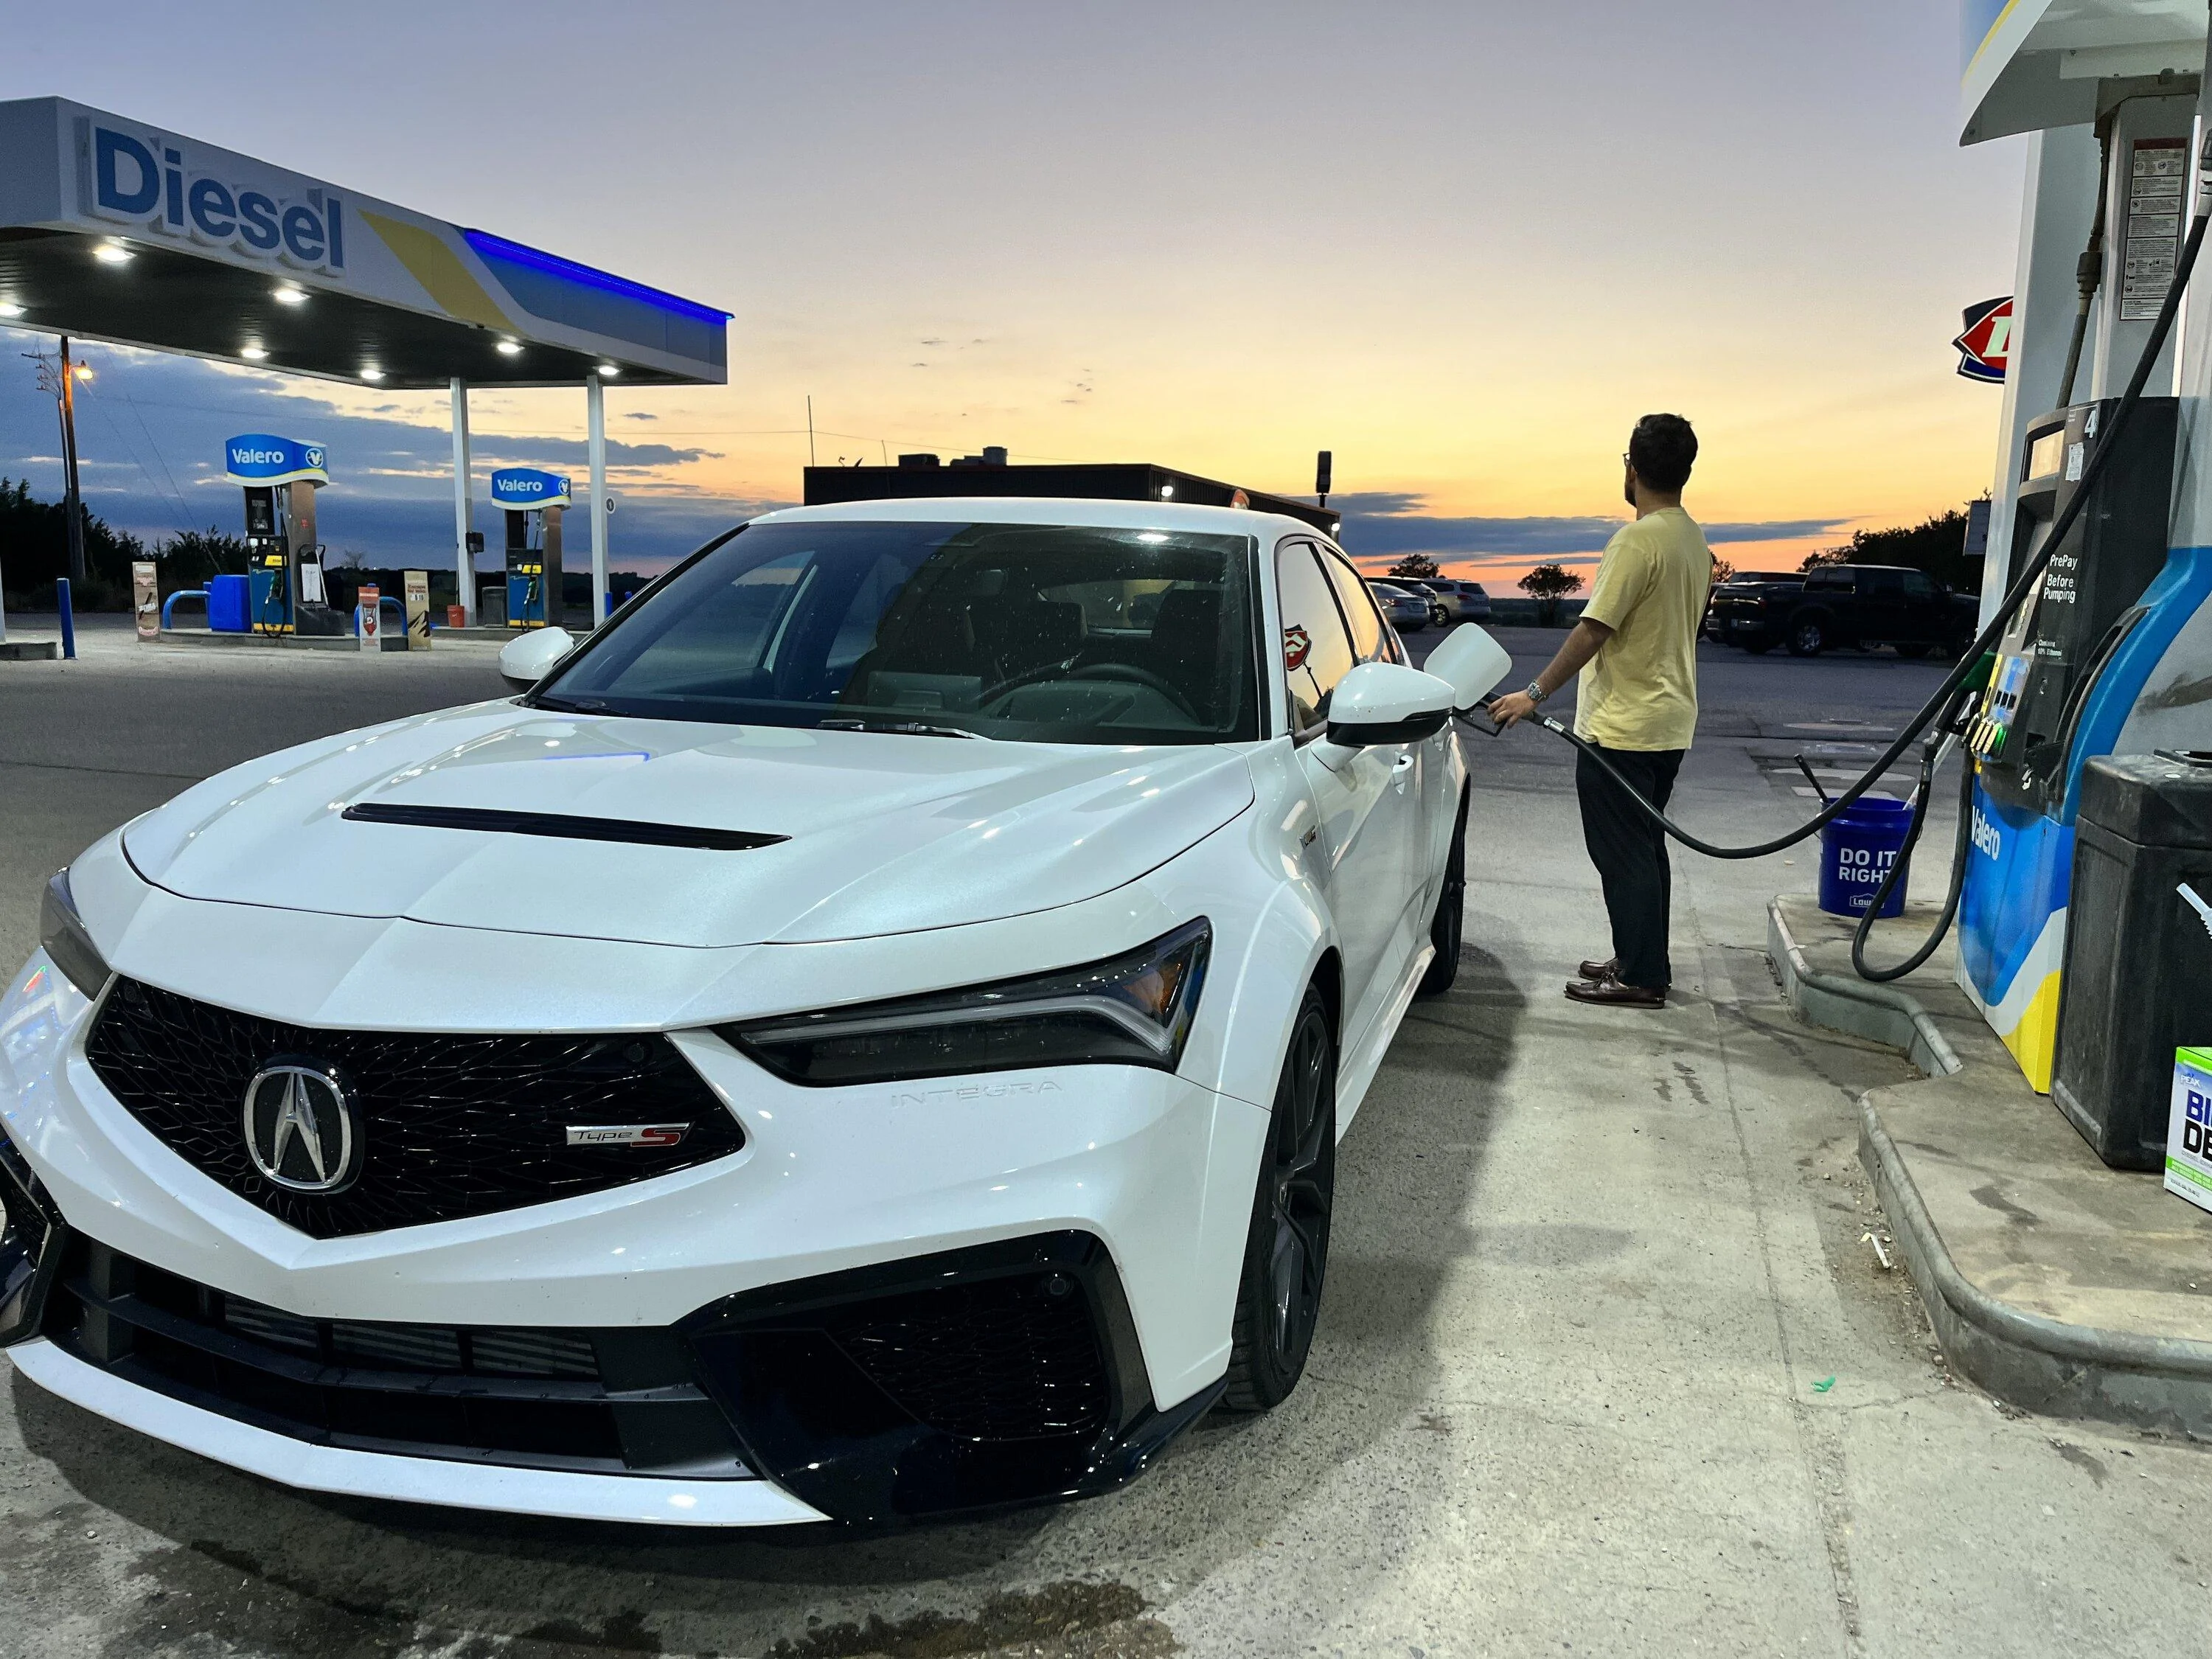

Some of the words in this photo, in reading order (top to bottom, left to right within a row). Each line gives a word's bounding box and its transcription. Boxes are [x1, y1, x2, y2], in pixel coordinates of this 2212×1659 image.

[95, 126, 344, 269] Diesel
[2084, 410, 2096, 438] 4
[232, 448, 285, 464] Valero
[497, 479, 543, 492] Valero
[2049, 554, 2079, 571] PrePay
[2047, 574, 2074, 588] Before
[2043, 587, 2076, 604] Pumping
[1971, 804, 2000, 861] Valero
[1840, 847, 1871, 866] DO
[1877, 850, 1897, 866] IT
[1838, 866, 1891, 883] RIGH
[2180, 1075, 2201, 1088] PEAK
[891, 1081, 1063, 1109] INTEGRA
[574, 1130, 633, 1141] Type
[630, 1128, 685, 1147] S
[2183, 1119, 2212, 1161] DE
